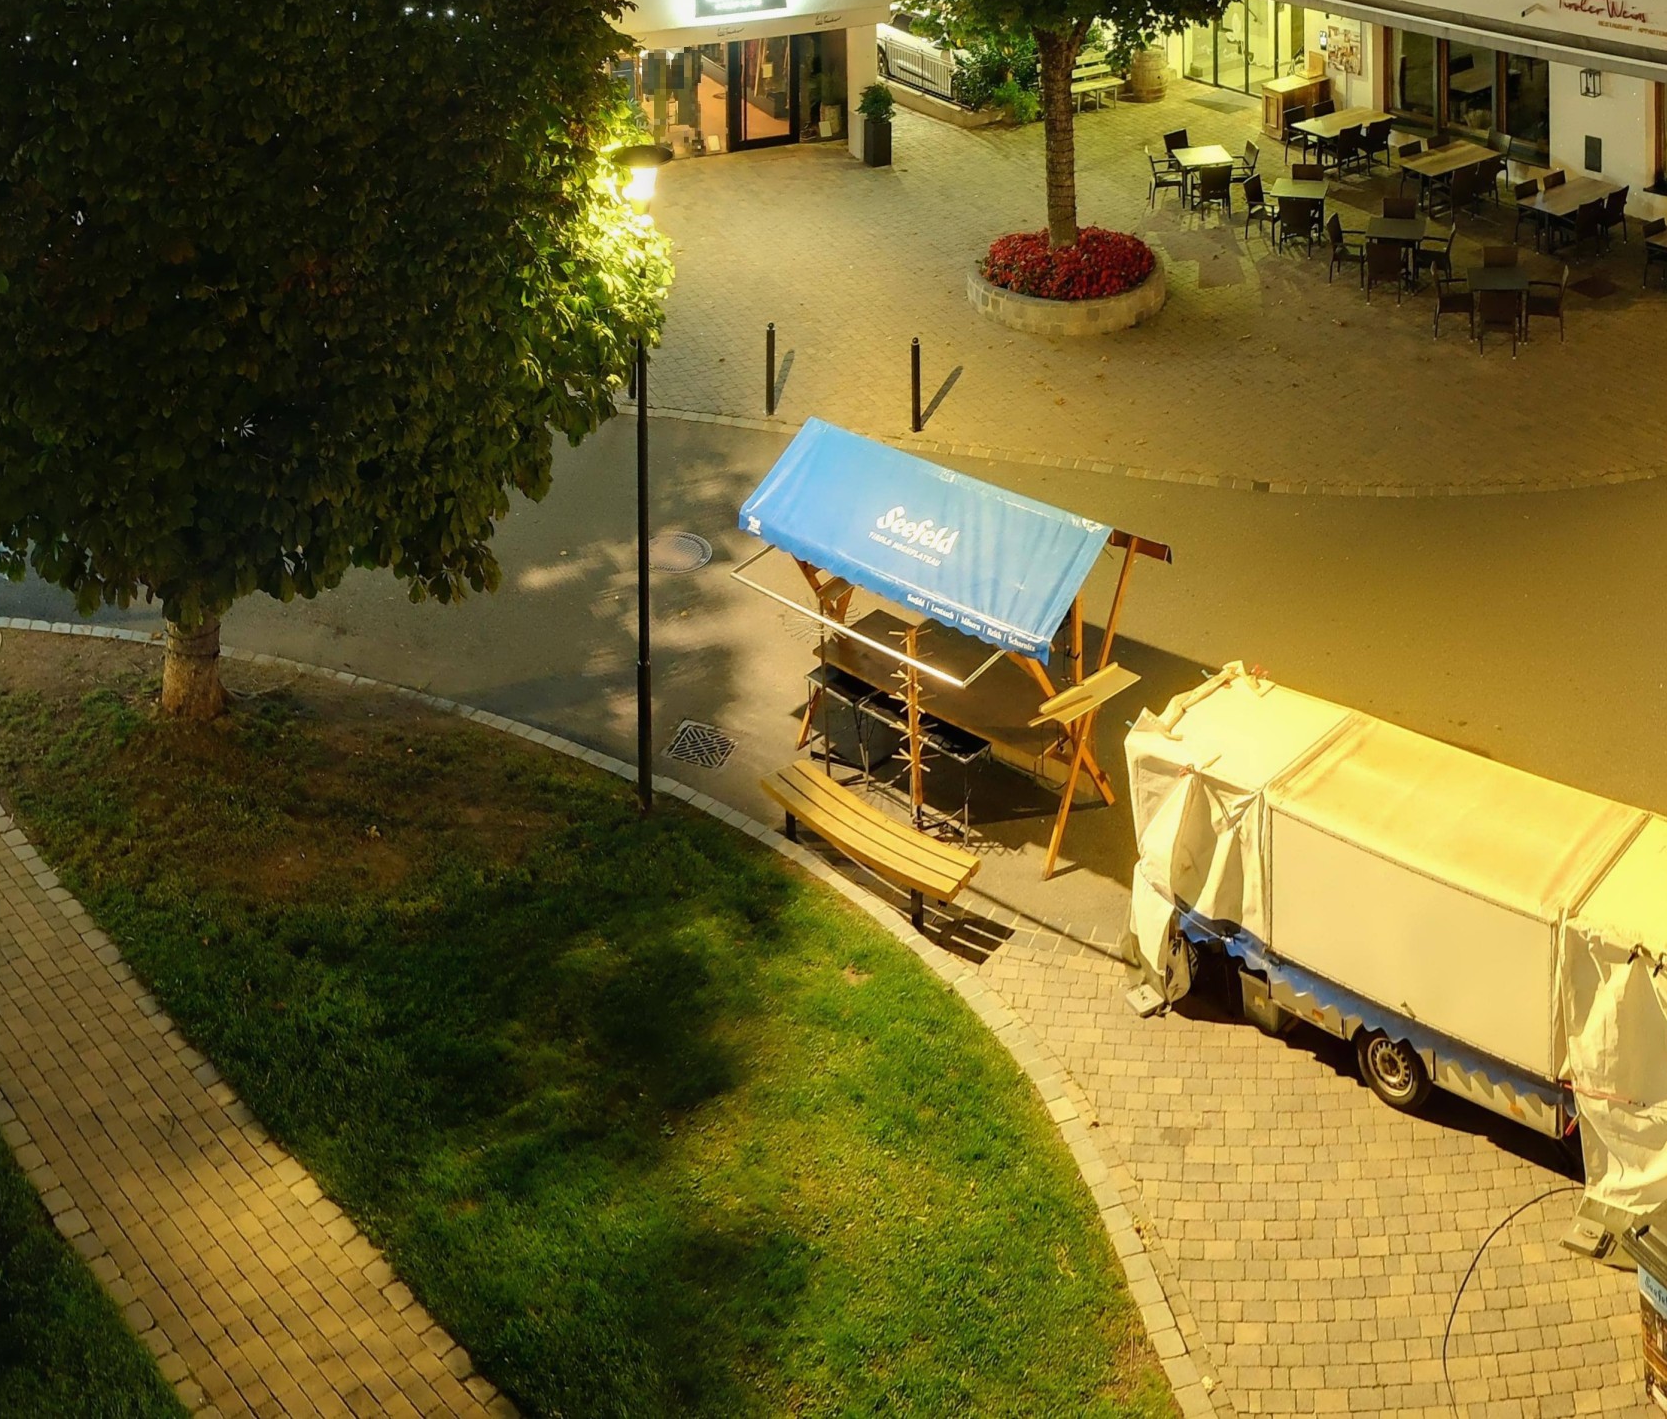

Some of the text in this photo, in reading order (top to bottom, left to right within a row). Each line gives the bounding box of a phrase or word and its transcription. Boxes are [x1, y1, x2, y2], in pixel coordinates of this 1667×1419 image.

[868, 531, 942, 568] TIROLS HOCHPLATEAU
[875, 504, 960, 556] Seefeld
[930, 603, 954, 621] Leutasch
[1007, 635, 1036, 653] Scharnitz
